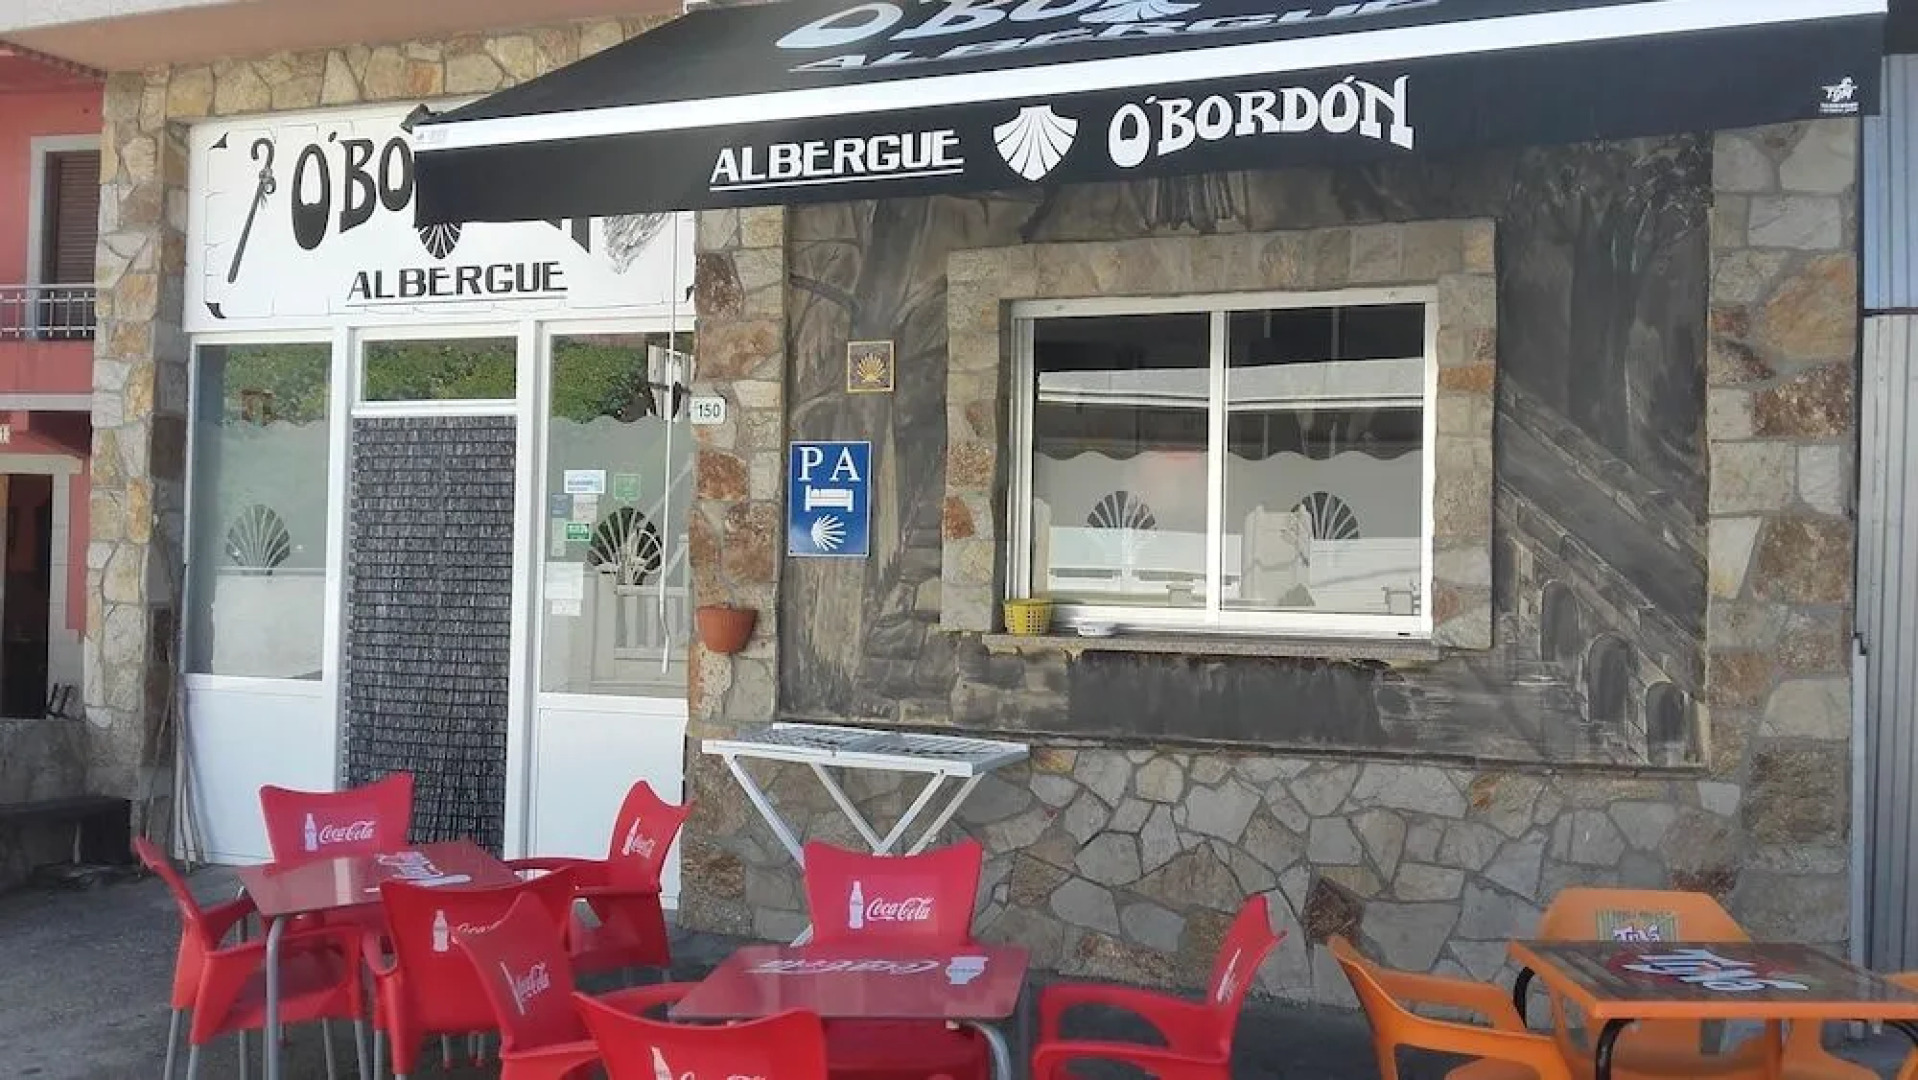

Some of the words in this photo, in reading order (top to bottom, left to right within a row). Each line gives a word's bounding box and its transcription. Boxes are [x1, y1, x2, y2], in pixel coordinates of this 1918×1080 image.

[709, 129, 965, 184] ALBERGUE
[346, 260, 568, 301] ALBERGUE
[699, 402, 721, 418] 150
